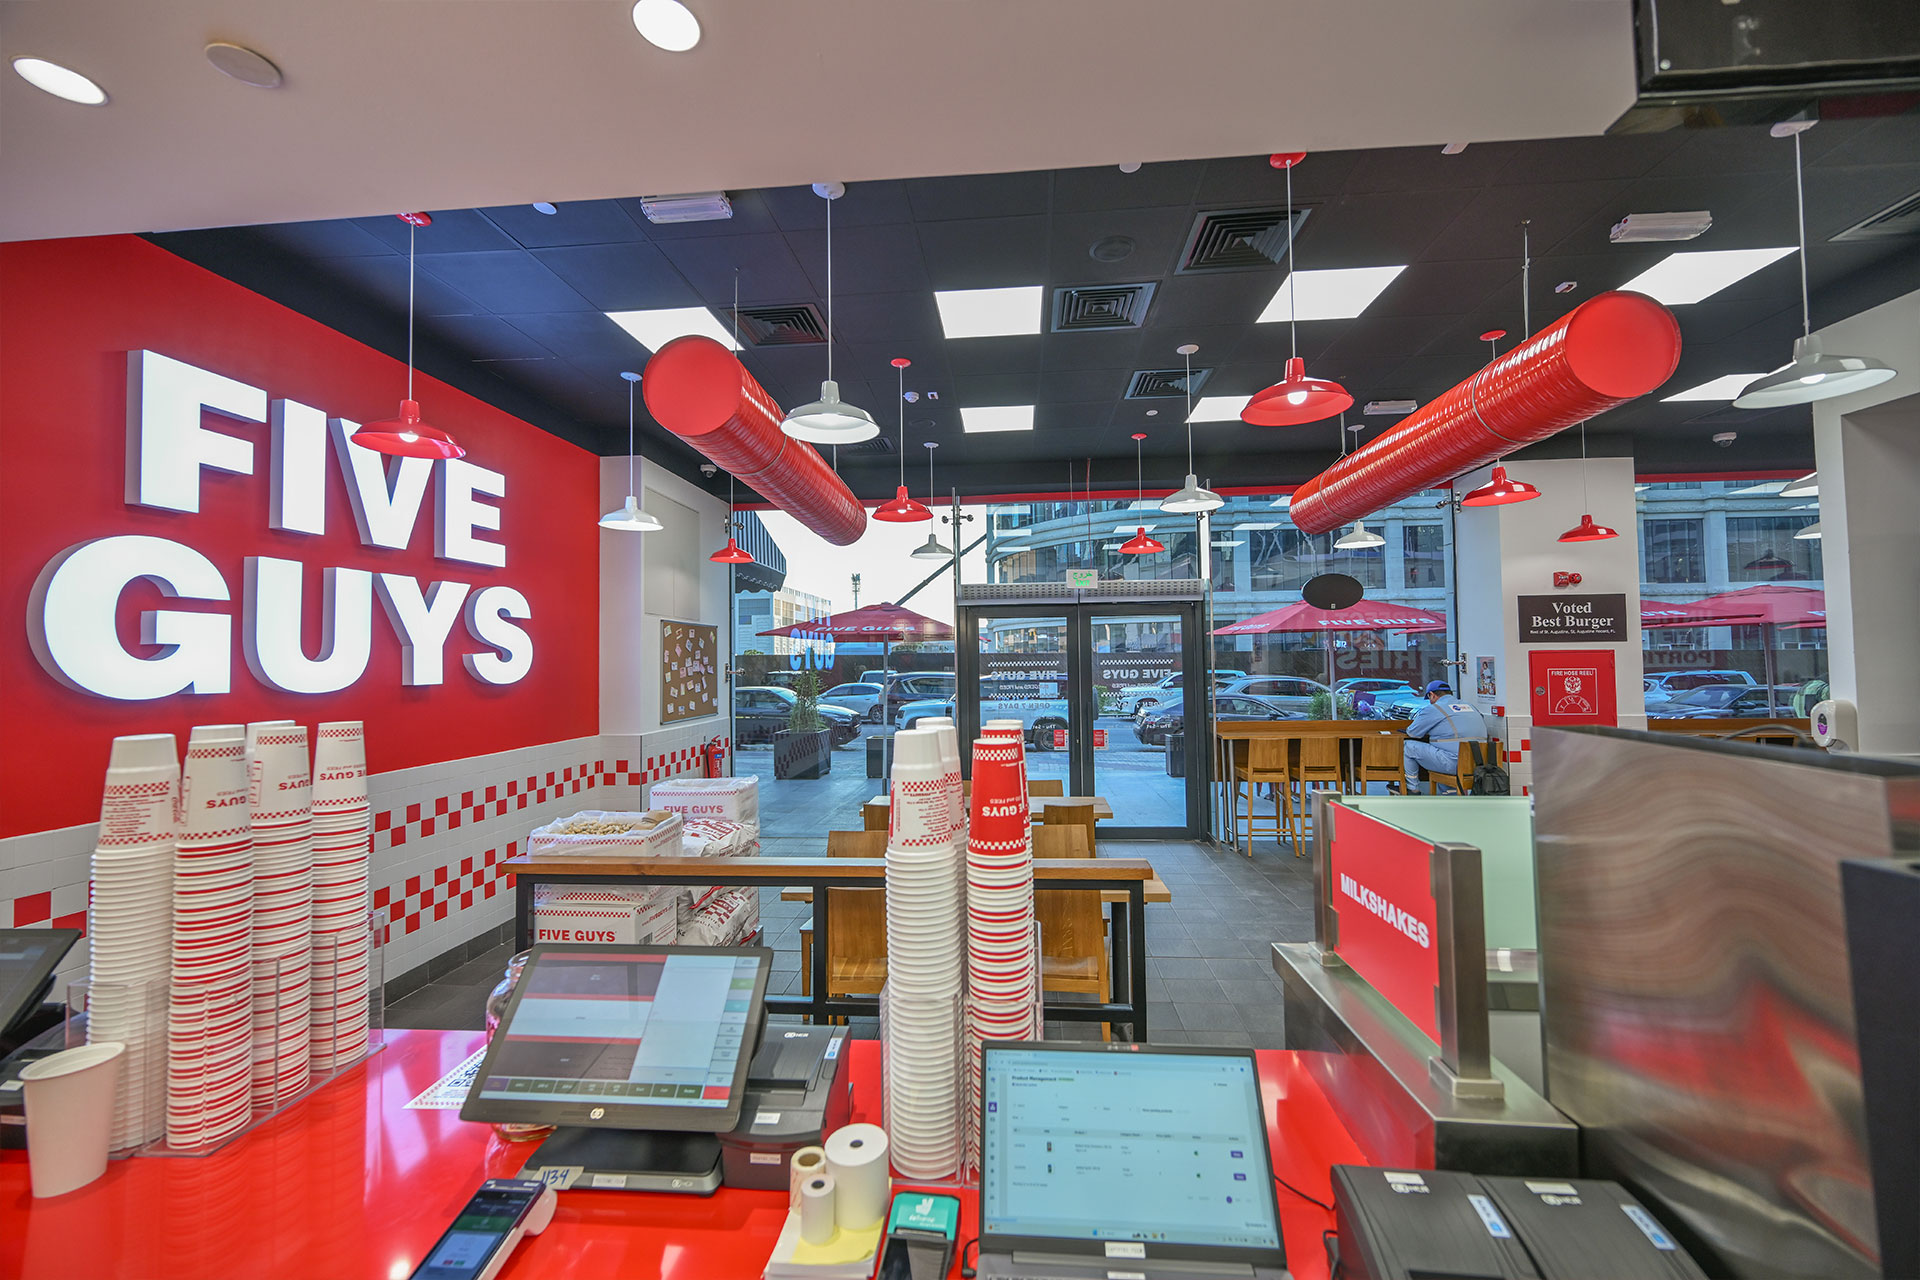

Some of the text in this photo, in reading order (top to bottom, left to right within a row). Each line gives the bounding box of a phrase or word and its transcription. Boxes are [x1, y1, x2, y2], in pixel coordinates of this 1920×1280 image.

[125, 349, 507, 568] FIVE
[1075, 579, 1090, 587] EXIT
[1552, 602, 1592, 614] Voted
[26, 535, 534, 701] GUYS
[1318, 617, 1436, 627] FIVE GUYS
[1532, 615, 1614, 629] Best Burger
[320, 770, 355, 781] GUYS
[205, 796, 248, 809] GUYS
[664, 805, 724, 814] FIVE GUYS
[982, 805, 1017, 818] GUYS
[1340, 873, 1430, 949] MILKSHAKES
[539, 929, 616, 943] FIVE GUYS
